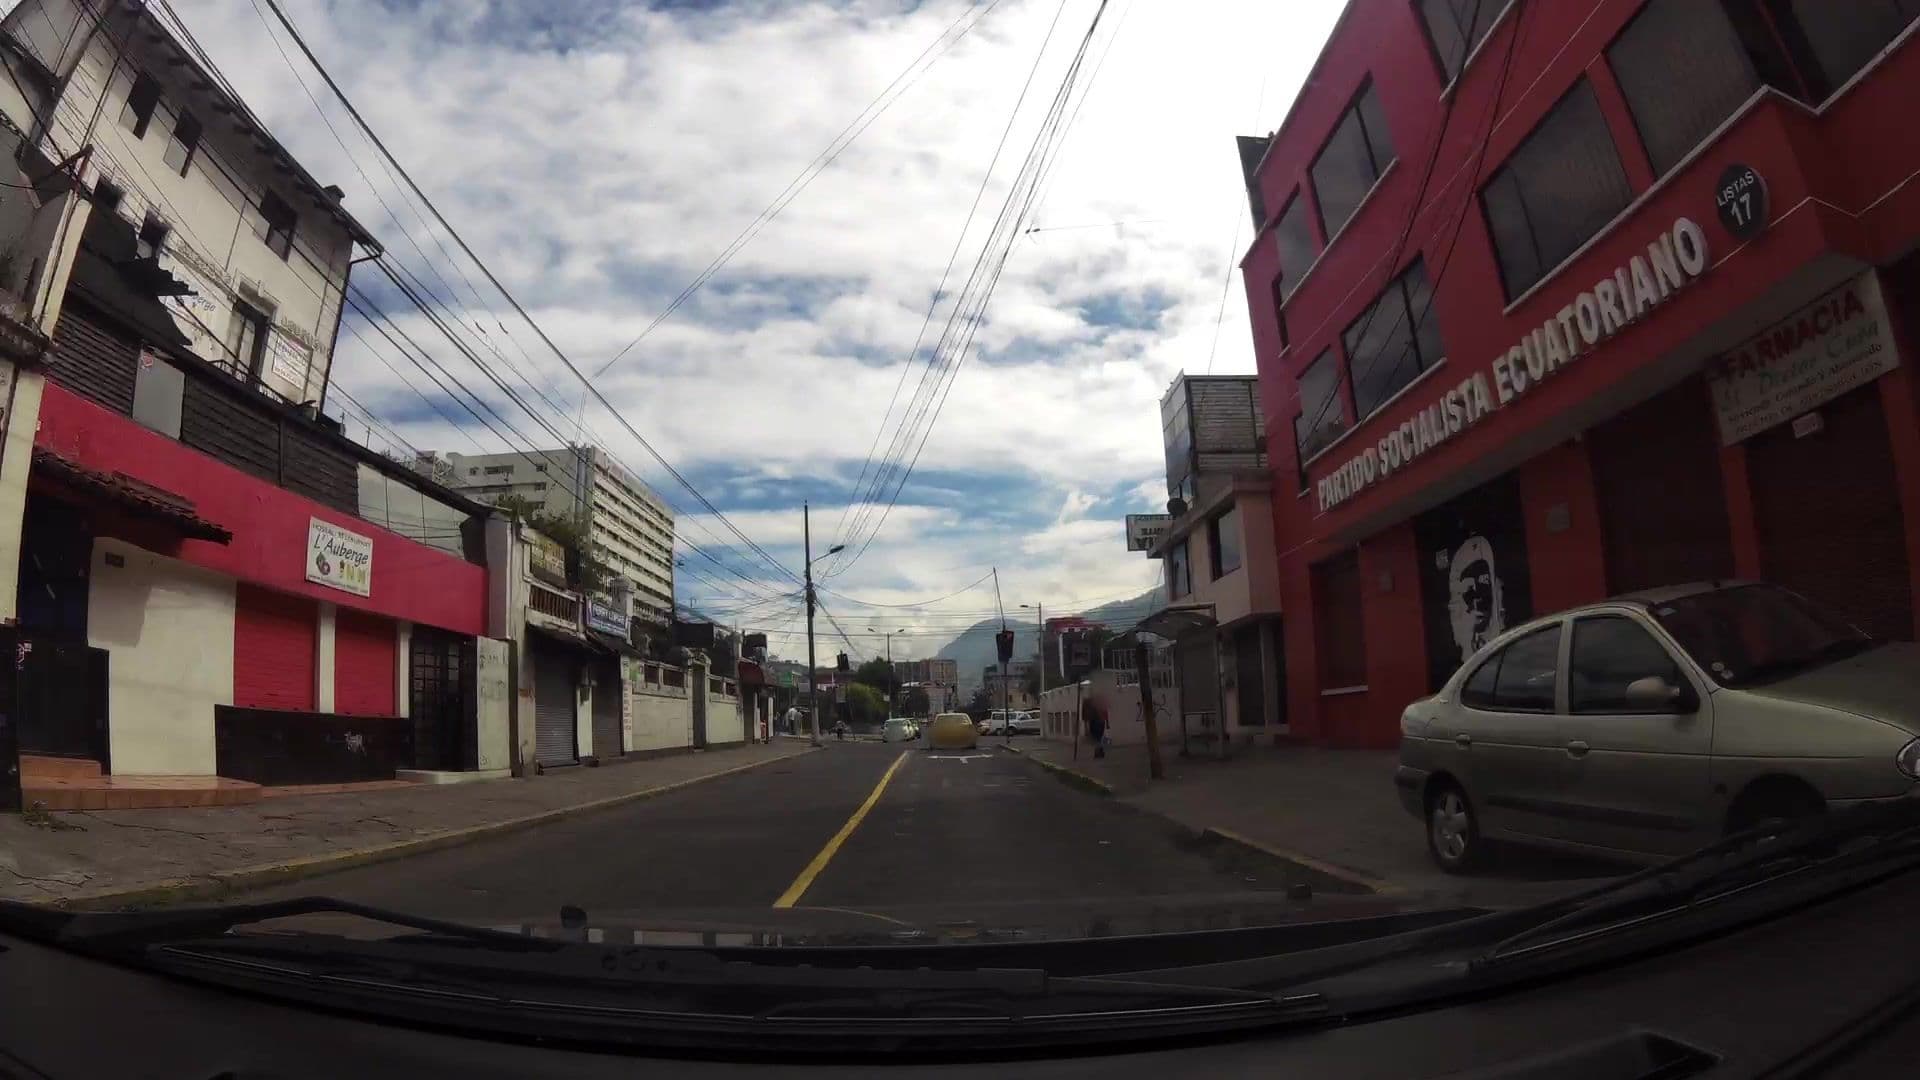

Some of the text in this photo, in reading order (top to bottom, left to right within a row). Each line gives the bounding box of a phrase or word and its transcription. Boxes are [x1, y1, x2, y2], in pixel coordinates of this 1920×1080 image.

[1716, 171, 1754, 207] LISTAS
[1731, 192, 1752, 226] 17
[1725, 288, 1866, 385] FARMACIA
[1317, 447, 1377, 512] PARTIDO
[1376, 371, 1496, 473] SOCIALISTA
[1492, 216, 1711, 406] ECUATORIANO
[313, 533, 369, 568] L'Auberge
